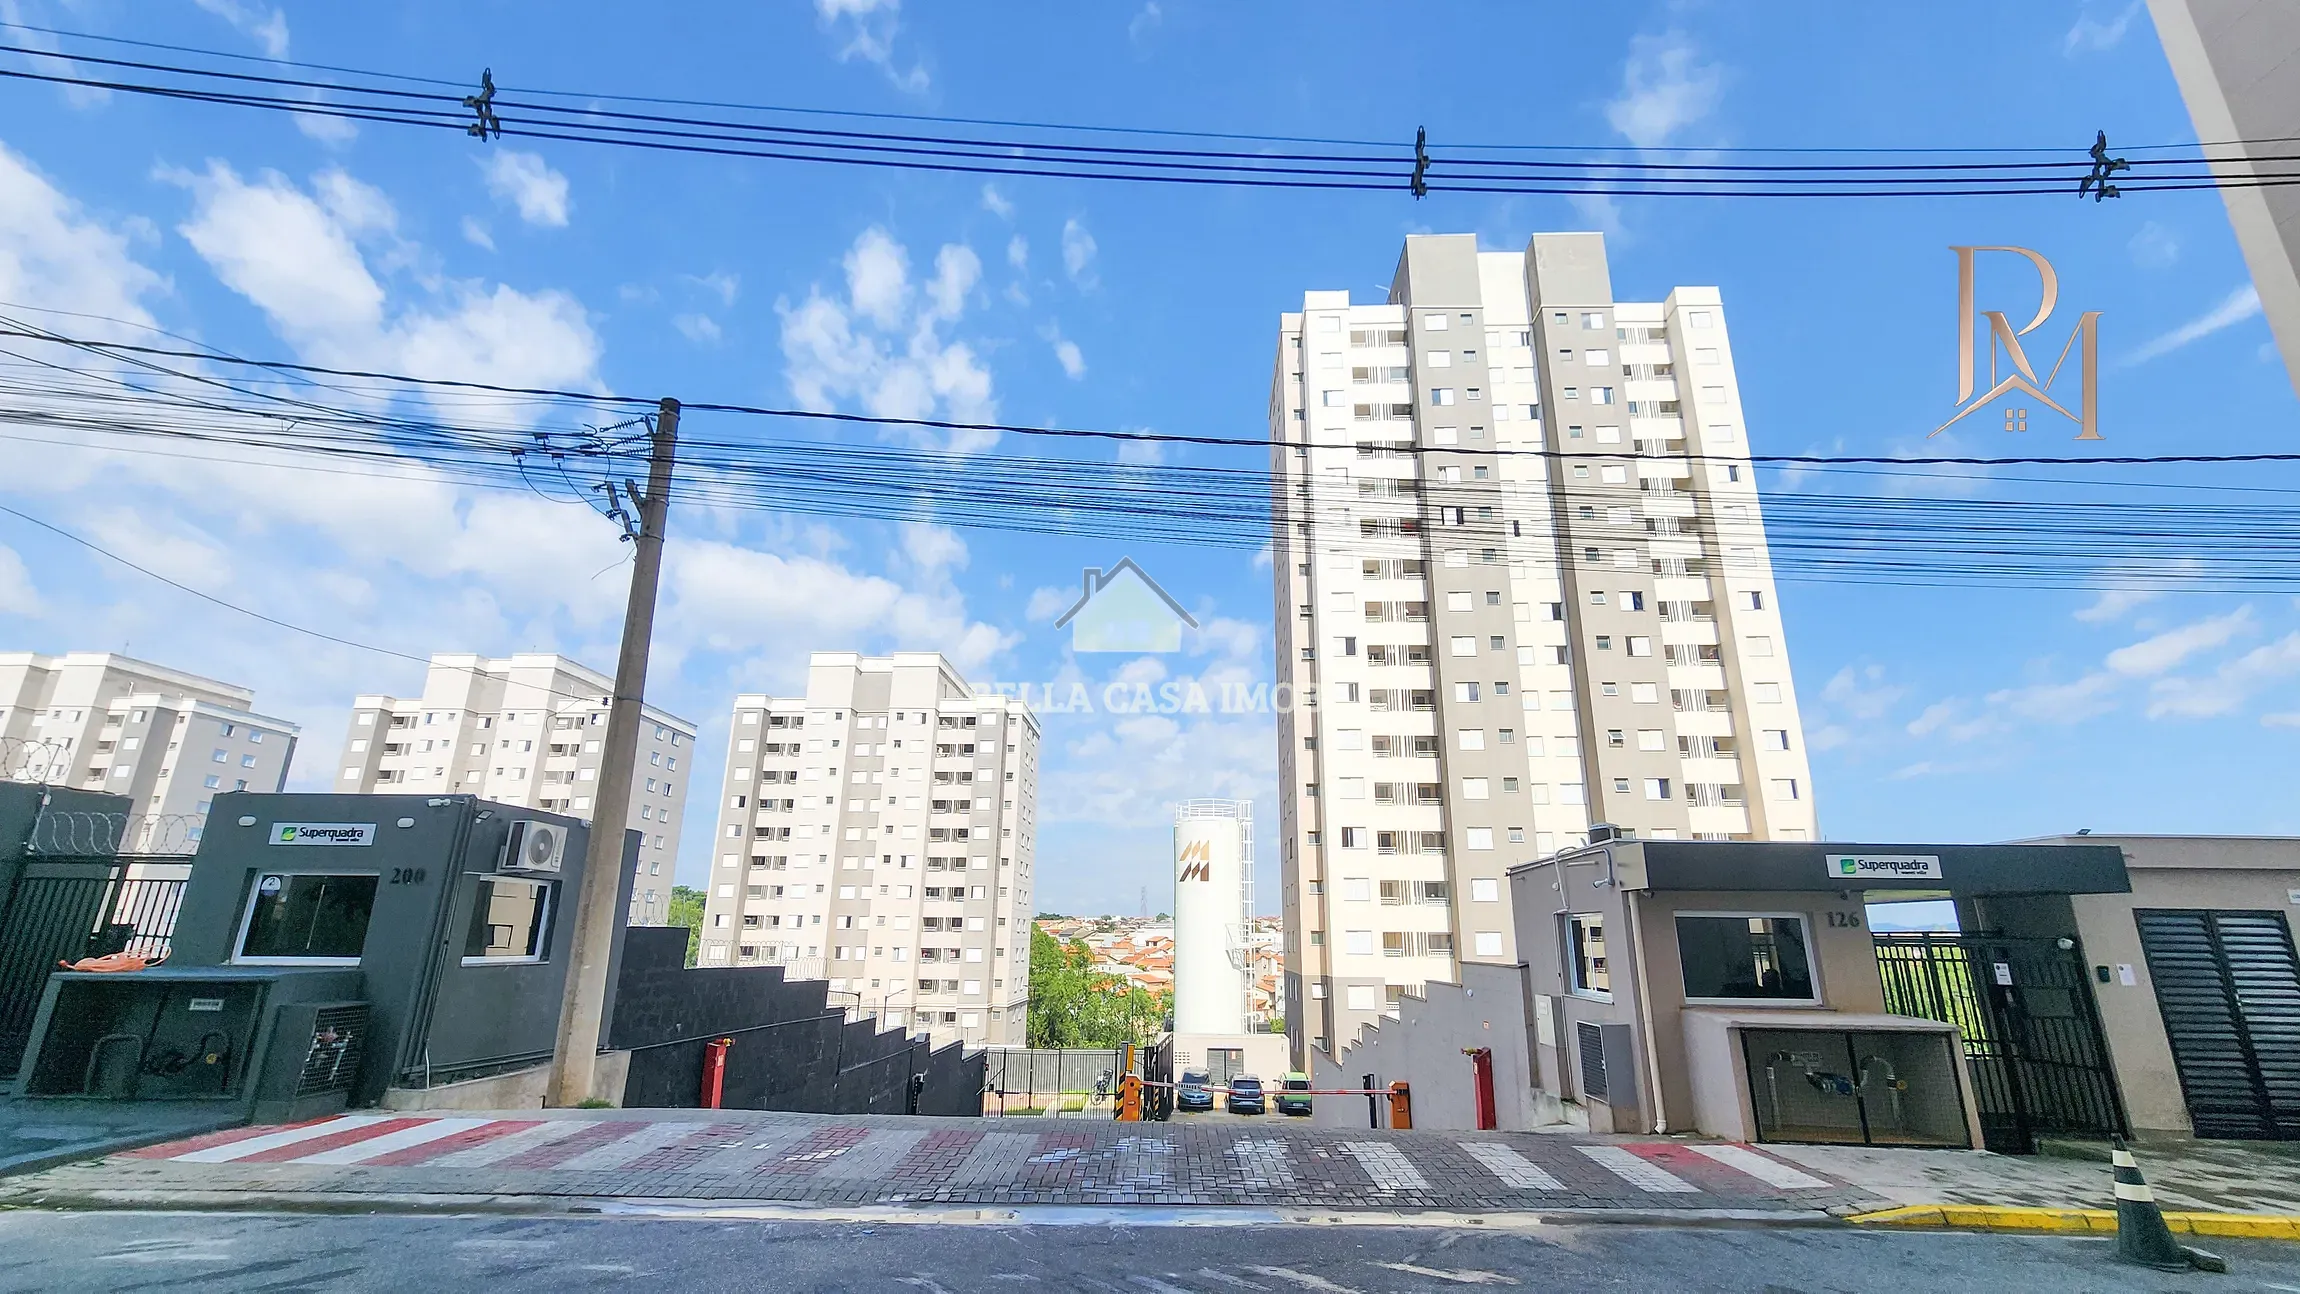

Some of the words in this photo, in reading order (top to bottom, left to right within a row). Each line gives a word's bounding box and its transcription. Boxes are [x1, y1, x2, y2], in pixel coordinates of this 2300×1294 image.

[298, 827, 364, 842] Superquadra
[1857, 859, 1929, 875] Superquadra
[389, 867, 427, 885] 200
[1825, 911, 1860, 928] 126
